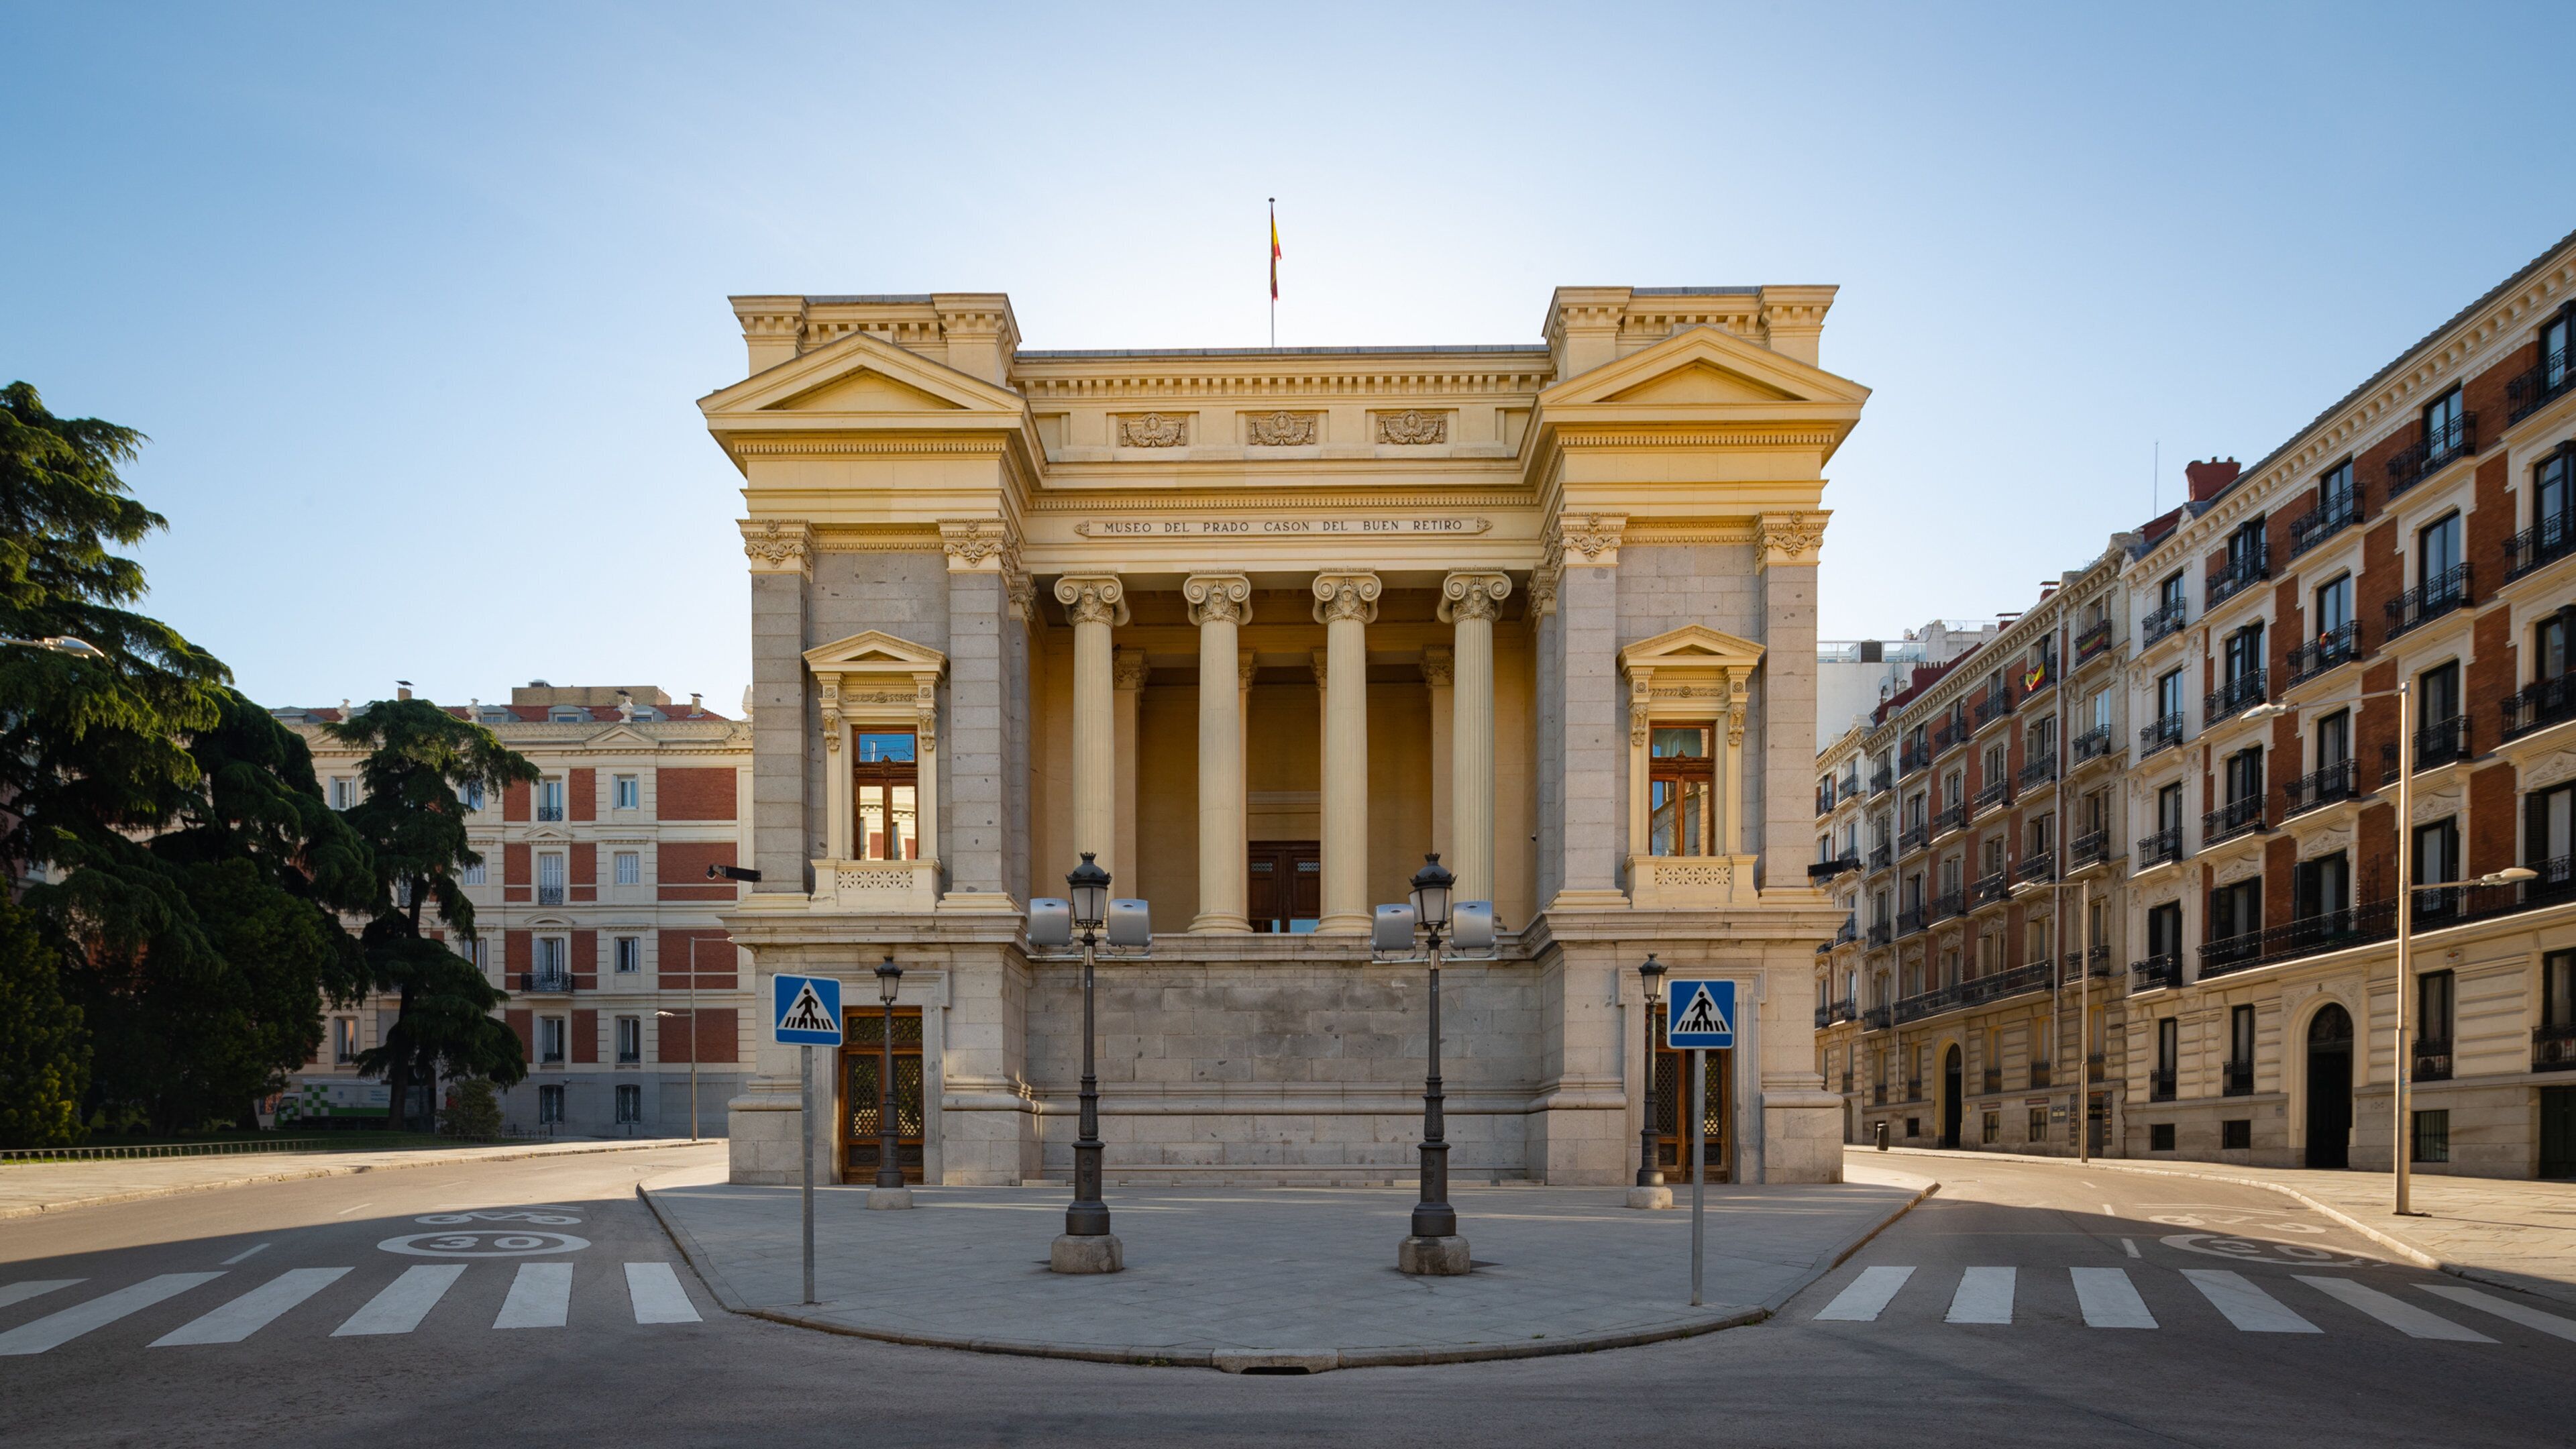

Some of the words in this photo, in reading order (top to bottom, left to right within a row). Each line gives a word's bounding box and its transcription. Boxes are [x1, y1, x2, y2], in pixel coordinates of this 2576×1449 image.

[1104, 523, 1152, 533] MUSEO
[1165, 522, 1191, 533] DEL
[1203, 522, 1249, 533] PRADO
[1264, 521, 1309, 532] CASON
[1323, 521, 1348, 531] DEL
[1362, 521, 1399, 531] BUEN
[1413, 520, 1462, 531] RETIRO
[2317, 982, 2323, 992] 8
[429, 1236, 544, 1250] 30
[2210, 1239, 2332, 1260] 30
